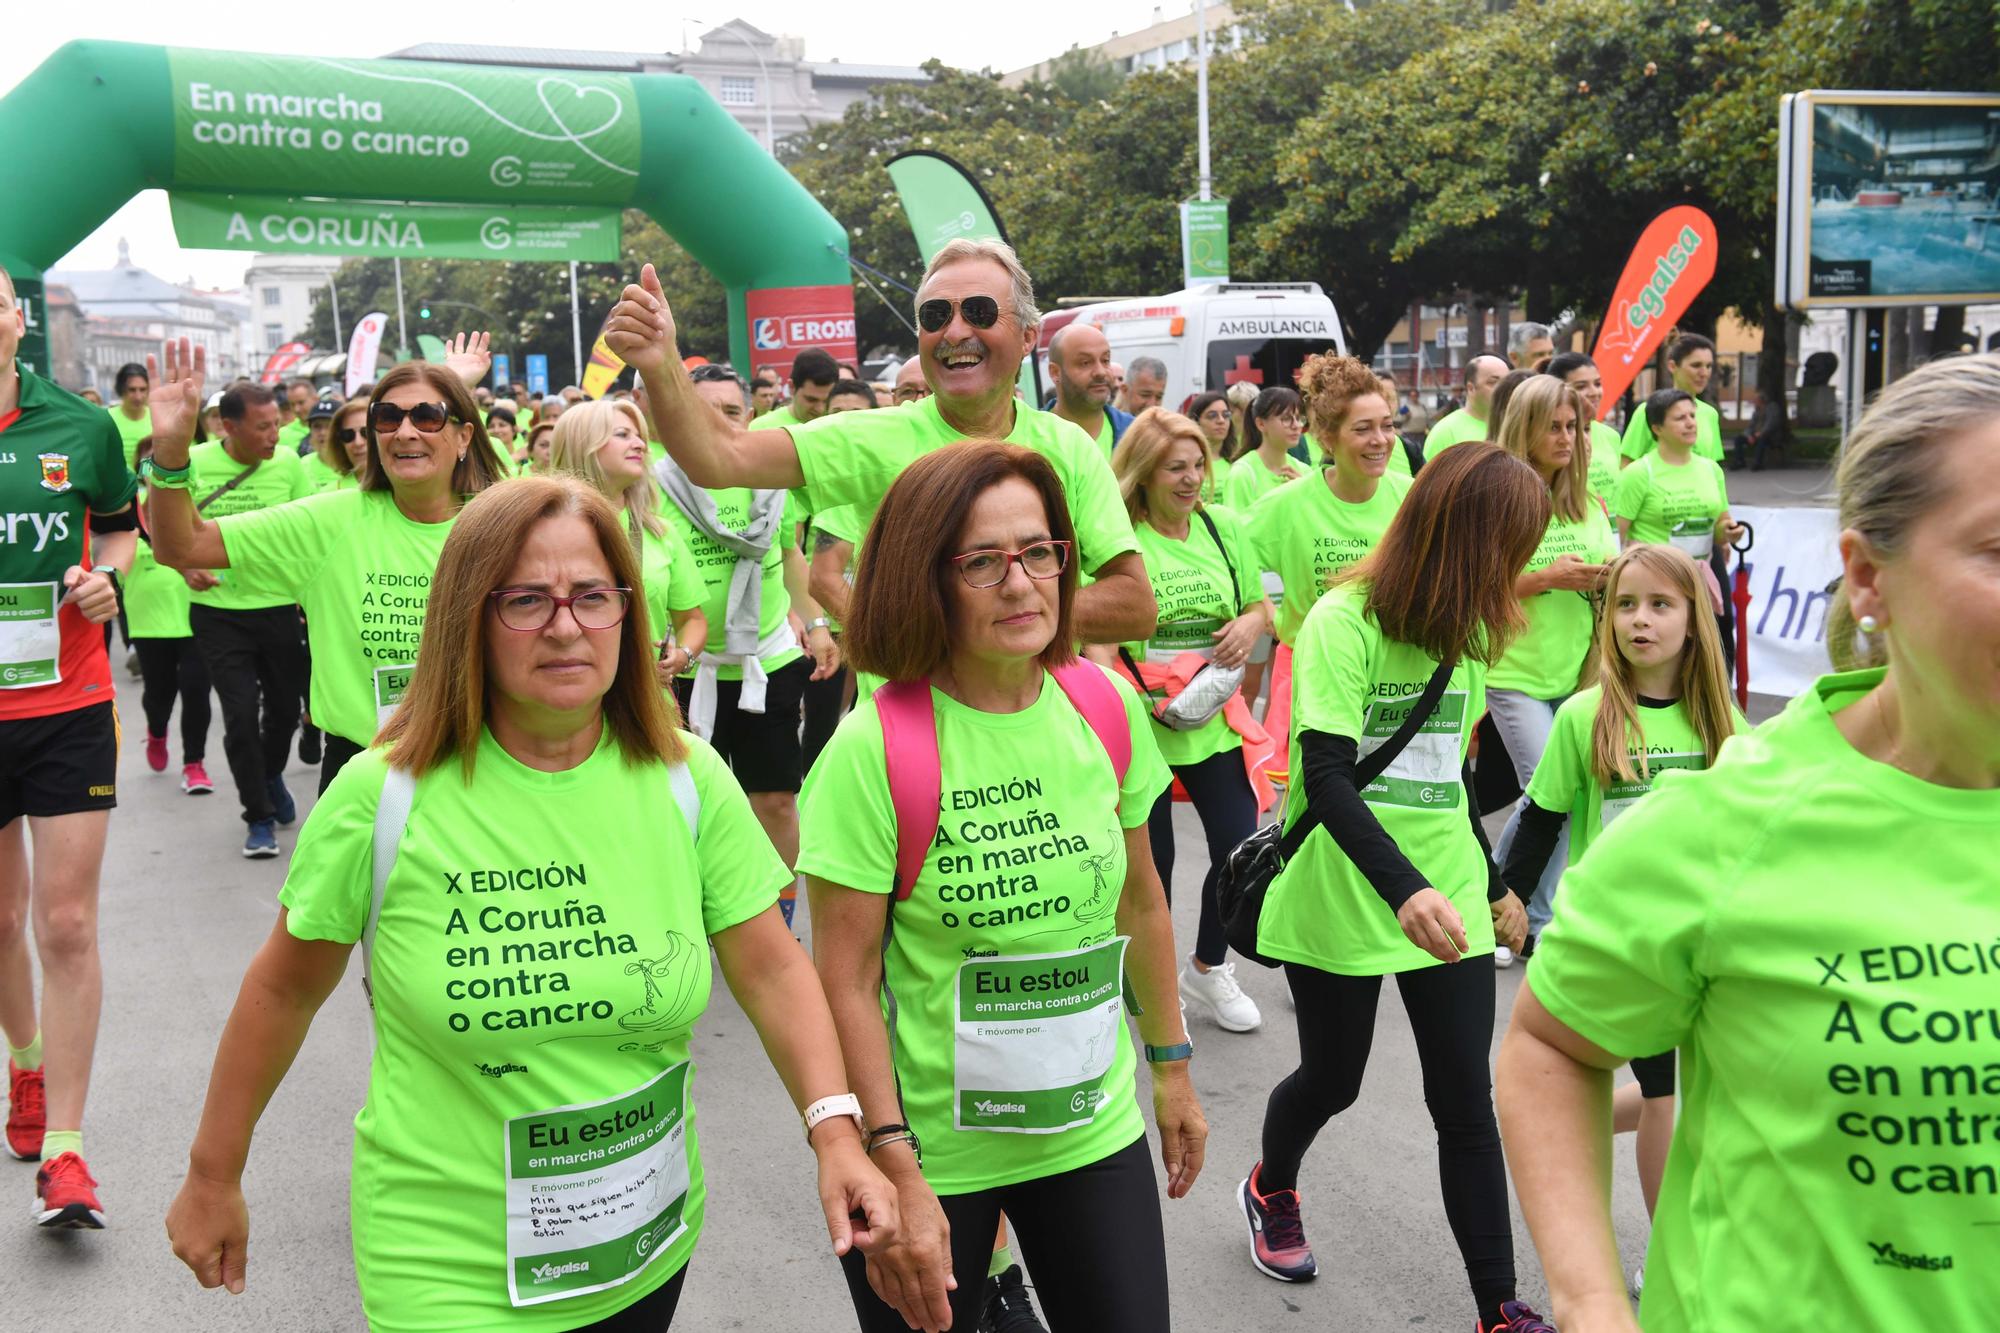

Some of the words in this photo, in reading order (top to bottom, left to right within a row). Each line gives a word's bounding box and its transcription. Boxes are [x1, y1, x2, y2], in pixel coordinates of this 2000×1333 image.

[189, 82, 236, 113] En
[245, 92, 384, 123] marcha
[193, 119, 312, 149] contra
[321, 129, 343, 151] o
[351, 130, 470, 158] cancro
[226, 212, 253, 242] A
[260, 213, 425, 248] CORUÑA
[1218, 320, 1328, 335] AMBULANCIA
[691, 535, 708, 546] en
[1313, 538, 1322, 548] X
[1324, 536, 1368, 548] EDICIÓN
[1313, 552, 1323, 563] A
[366, 573, 375, 585] X
[378, 573, 432, 588] EDICIÓ
[1151, 576, 1158, 584] X
[1160, 568, 1202, 582] EDICIÓN
[1155, 588, 1163, 599] A
[1165, 580, 1212, 596] Coruña
[362, 592, 375, 606] A
[380, 592, 428, 609] Coru
[1177, 592, 1222, 608] marcha
[362, 611, 384, 624] en
[1156, 627, 1172, 638] Eu
[1176, 626, 1209, 638] estou
[363, 647, 373, 658] o
[1379, 708, 1399, 721] Eu
[952, 777, 1043, 811] EDICIÓN
[935, 824, 955, 848] A
[960, 809, 1061, 844] Coruña
[937, 854, 974, 874] en
[983, 834, 1090, 871] marcha
[444, 872, 463, 894] X
[471, 861, 587, 893] EDICIÓN
[938, 874, 1039, 902] contra
[445, 908, 469, 935] A
[479, 899, 607, 934] Coruña
[941, 911, 960, 929] o
[968, 895, 1071, 928] cancro
[446, 945, 490, 967] en
[502, 930, 638, 964] marcha
[975, 971, 1011, 994] Eu
[1019, 966, 1090, 993] estou
[1815, 953, 1848, 986] X
[446, 969, 571, 1000] contra
[975, 1002, 992, 1012] en
[994, 1000, 1043, 1012] marcha
[1045, 996, 1081, 1009] contra
[1082, 992, 1090, 1002] o
[1090, 982, 1113, 999] cancro
[448, 1012, 470, 1032] o
[481, 1000, 614, 1032] cancro
[1825, 1000, 1863, 1044] A
[977, 1027, 983, 1036] E
[984, 1027, 1025, 1036] móvome
[1026, 1026, 1047, 1036] por...
[474, 1063, 529, 1078] Vegalsa
[1828, 1063, 1900, 1096] en
[974, 1099, 1026, 1116] Vegalsa
[528, 1122, 570, 1149] Eu
[578, 1100, 655, 1142] estou
[528, 1157, 548, 1168] en
[551, 1147, 606, 1168] marcha
[608, 1133, 646, 1155] contra
[646, 1128, 654, 1139] o
[654, 1107, 677, 1133] cancro
[1837, 1106, 2000, 1146] contr
[1847, 1154, 1875, 1185] o
[530, 1194, 555, 1205] Min
[531, 1184, 538, 1193] E
[540, 1181, 586, 1193] móvome
[567, 1203, 587, 1213] que
[578, 1212, 600, 1223] que
[531, 1261, 590, 1279] Vegalsa
[1867, 1240, 1953, 1272] Vegalsa
